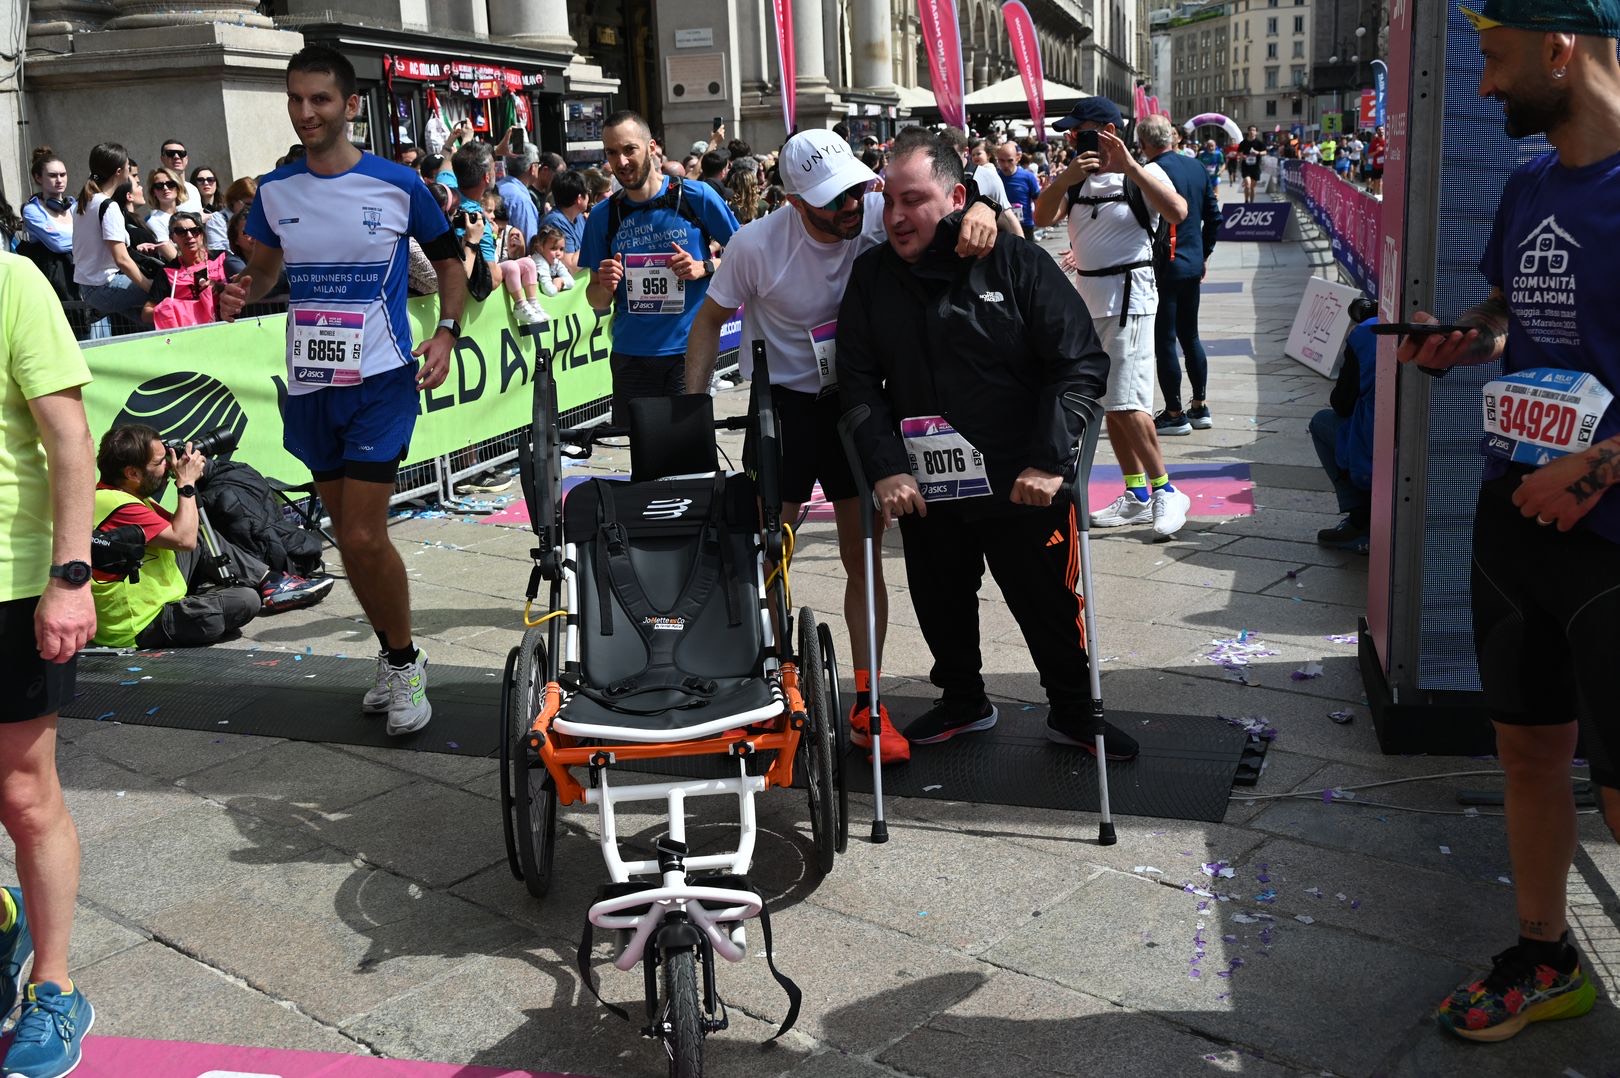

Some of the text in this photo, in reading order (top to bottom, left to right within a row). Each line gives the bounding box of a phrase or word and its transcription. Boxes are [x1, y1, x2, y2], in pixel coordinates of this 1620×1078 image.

[409, 62, 440, 76] AC MILAN
[1240, 211, 1275, 226] asics
[634, 224, 654, 236] RUN
[632, 235, 651, 247] RUN
[664, 228, 687, 240] LYON
[291, 273, 379, 283] DAD RUNNERS CLUB
[313, 285, 347, 294] MILANO
[643, 277, 668, 295] 958
[1511, 291, 1575, 306] OKLAHOMA
[319, 329, 336, 337] MICHELE
[307, 338, 347, 363] 6855
[306, 369, 325, 378] asics
[1495, 440, 1510, 451] asics
[922, 447, 967, 476] 8076
[927, 484, 948, 494] asics
